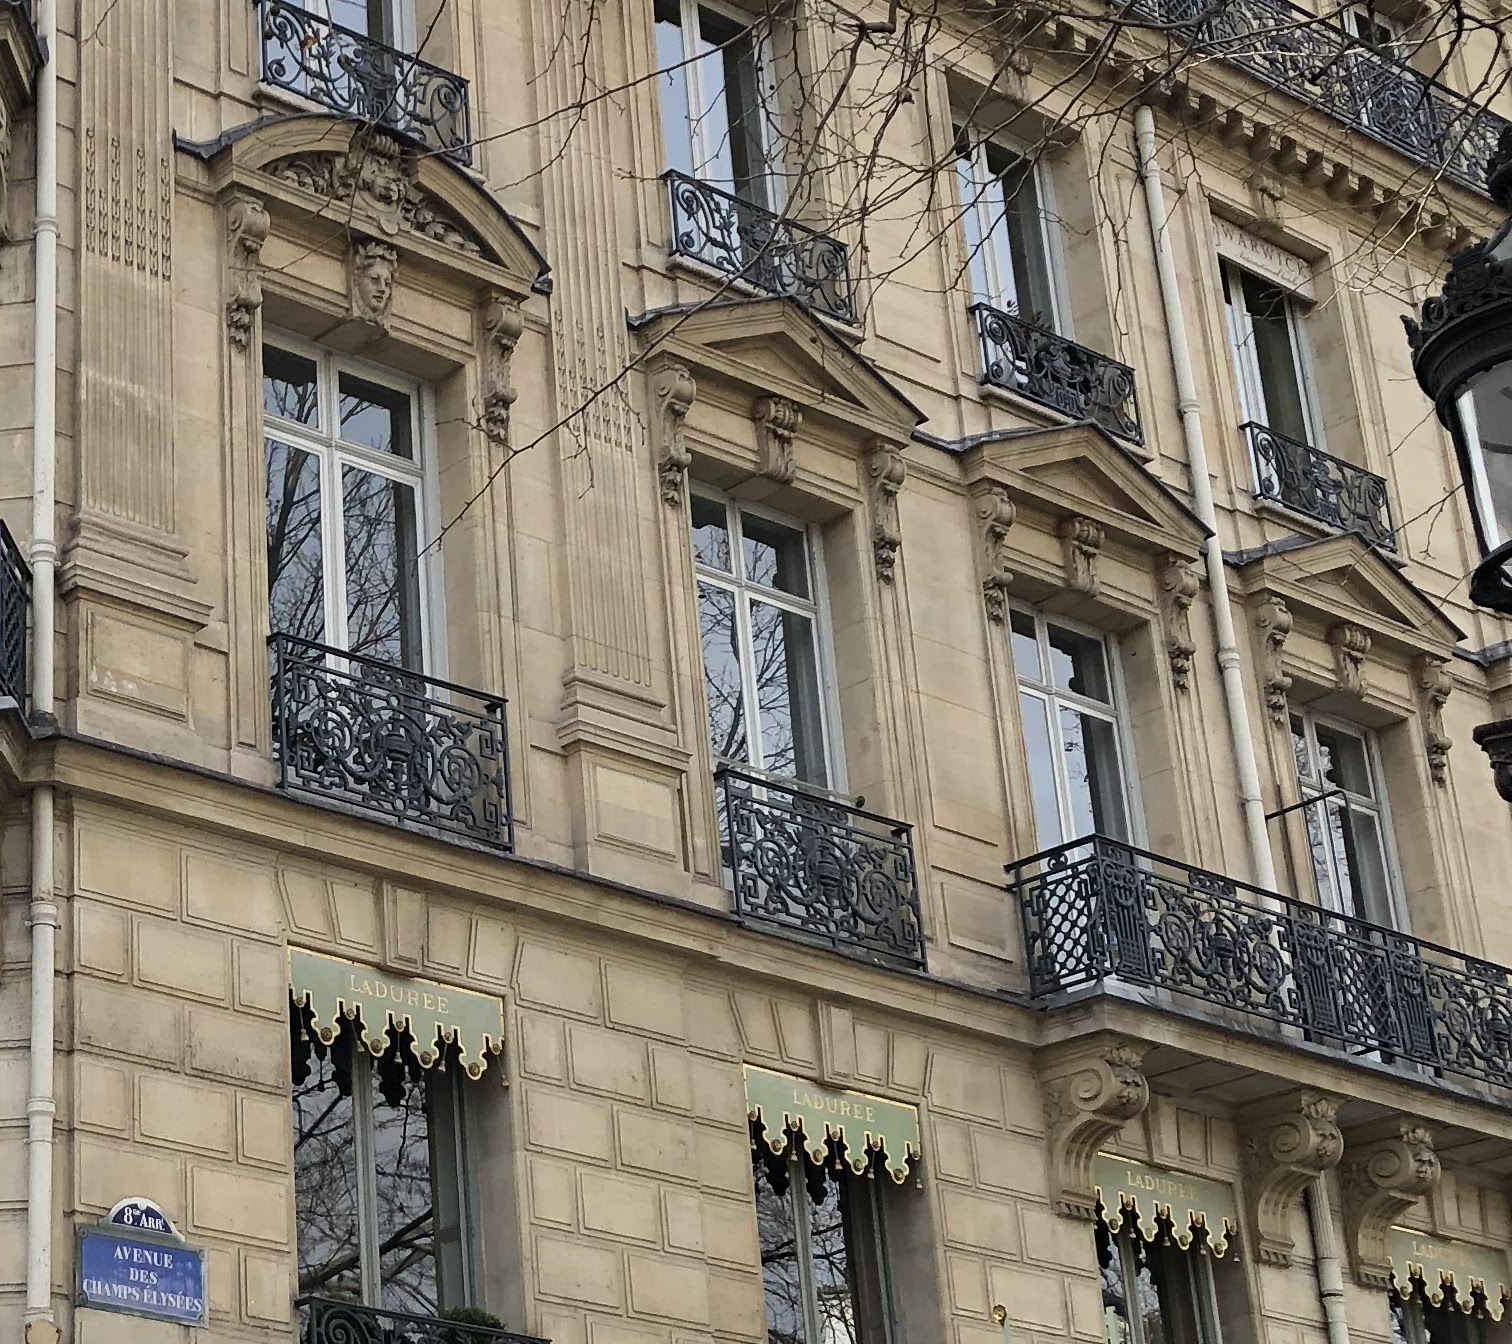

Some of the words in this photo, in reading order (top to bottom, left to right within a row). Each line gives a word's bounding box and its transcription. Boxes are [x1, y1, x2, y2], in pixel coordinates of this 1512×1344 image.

[349, 974, 451, 1014] LADUREE
[792, 1089, 876, 1123] LADUREE
[113, 1245, 174, 1269] AVENUE
[129, 1267, 158, 1285] DES
[83, 1278, 140, 1302] CHAMPS
[143, 1285, 203, 1312] ÉLYSÉES
